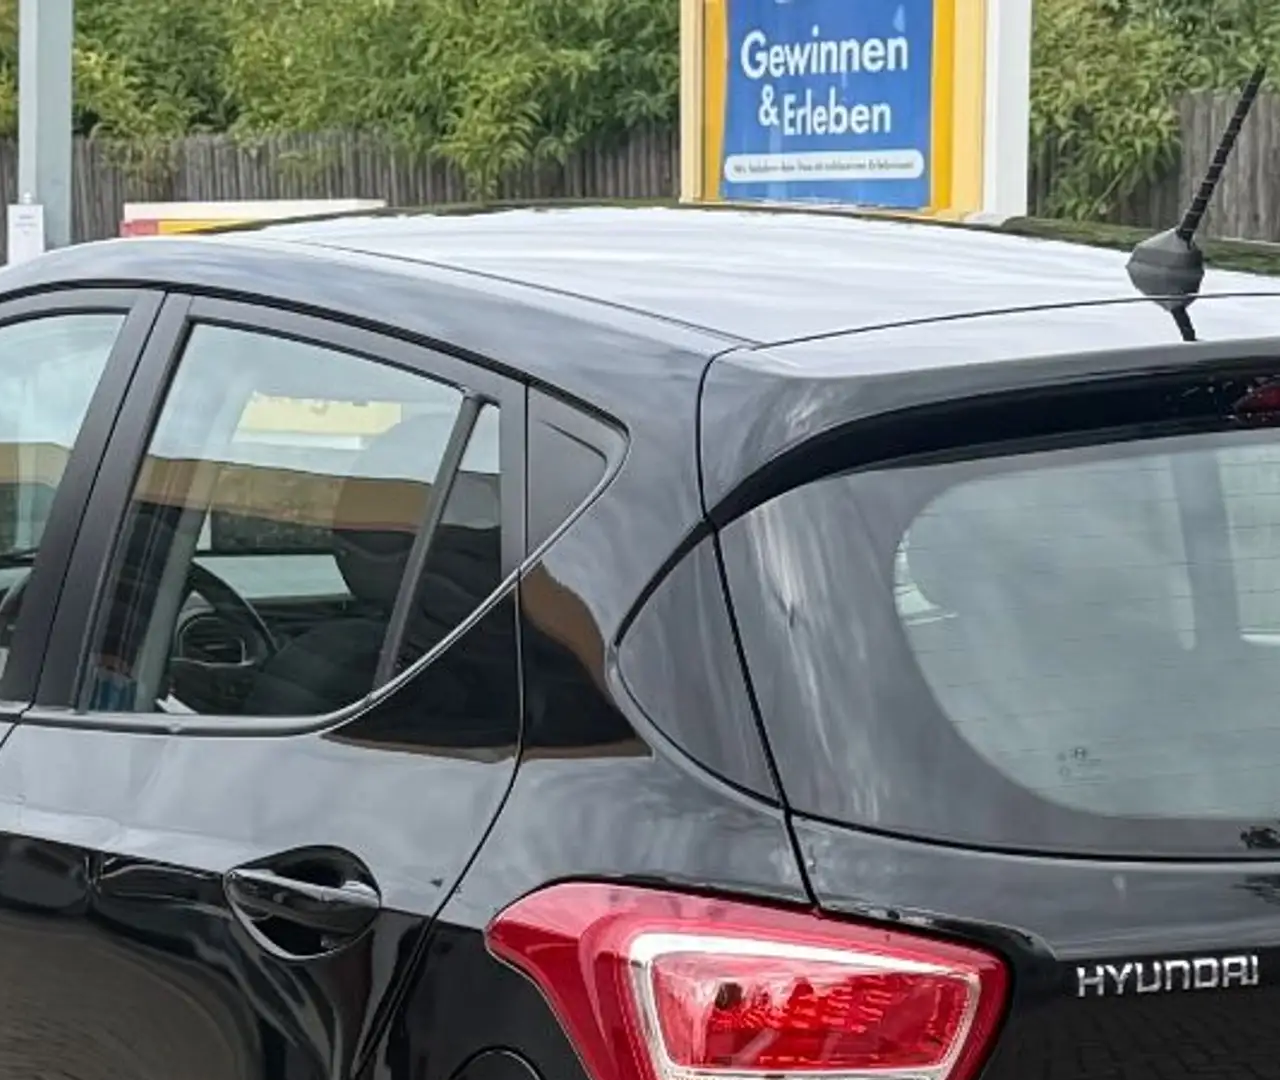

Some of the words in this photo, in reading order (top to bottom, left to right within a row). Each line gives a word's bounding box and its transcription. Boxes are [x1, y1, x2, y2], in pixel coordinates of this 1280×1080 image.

[740, 24, 909, 79] Gewinnen
[783, 85, 892, 136] Erleben
[1076, 954, 1260, 998] HYUNDAI
